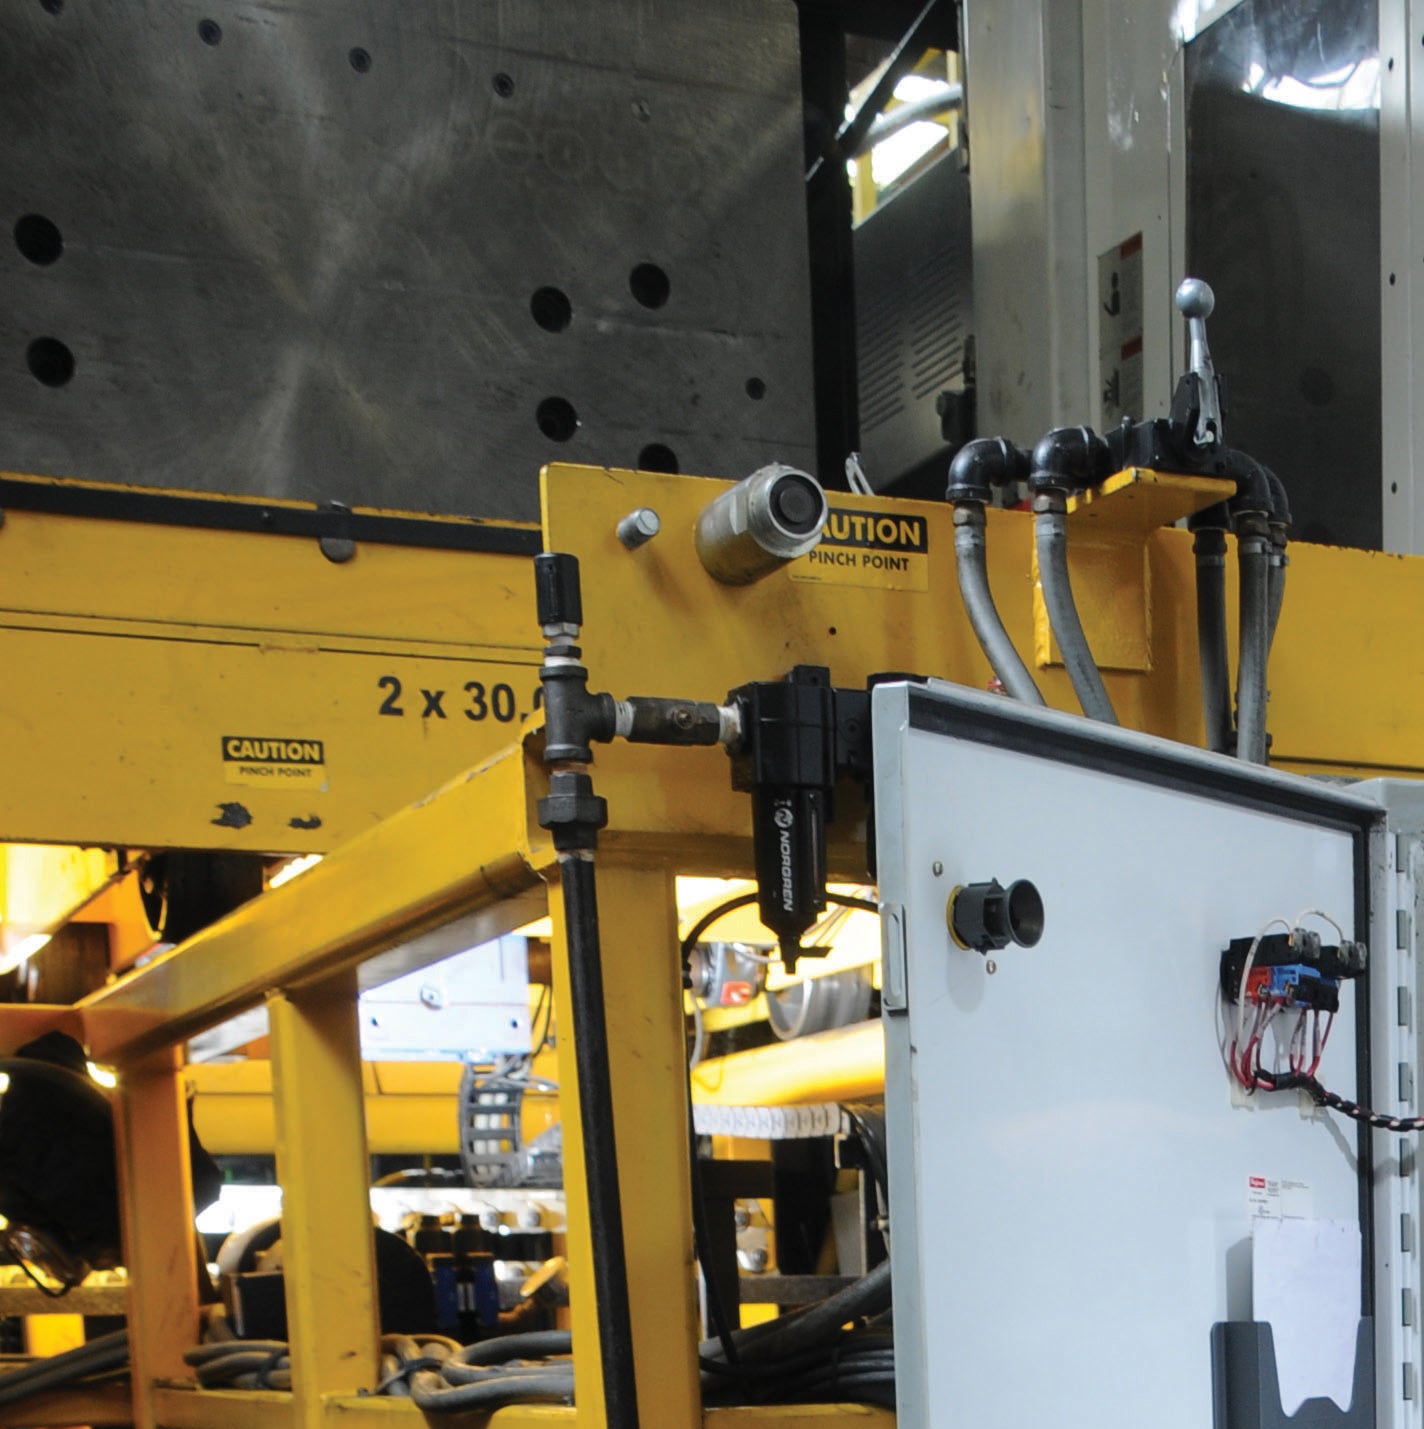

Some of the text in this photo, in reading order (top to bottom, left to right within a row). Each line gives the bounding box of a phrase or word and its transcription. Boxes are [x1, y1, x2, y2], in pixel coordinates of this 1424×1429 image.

[821, 513, 921, 546] UTION
[809, 551, 910, 571] PINCH POINT
[378, 675, 404, 716] 2
[420, 689, 447, 718] x
[226, 739, 320, 761] CAUTION
[239, 765, 312, 778] PINCH POINT
